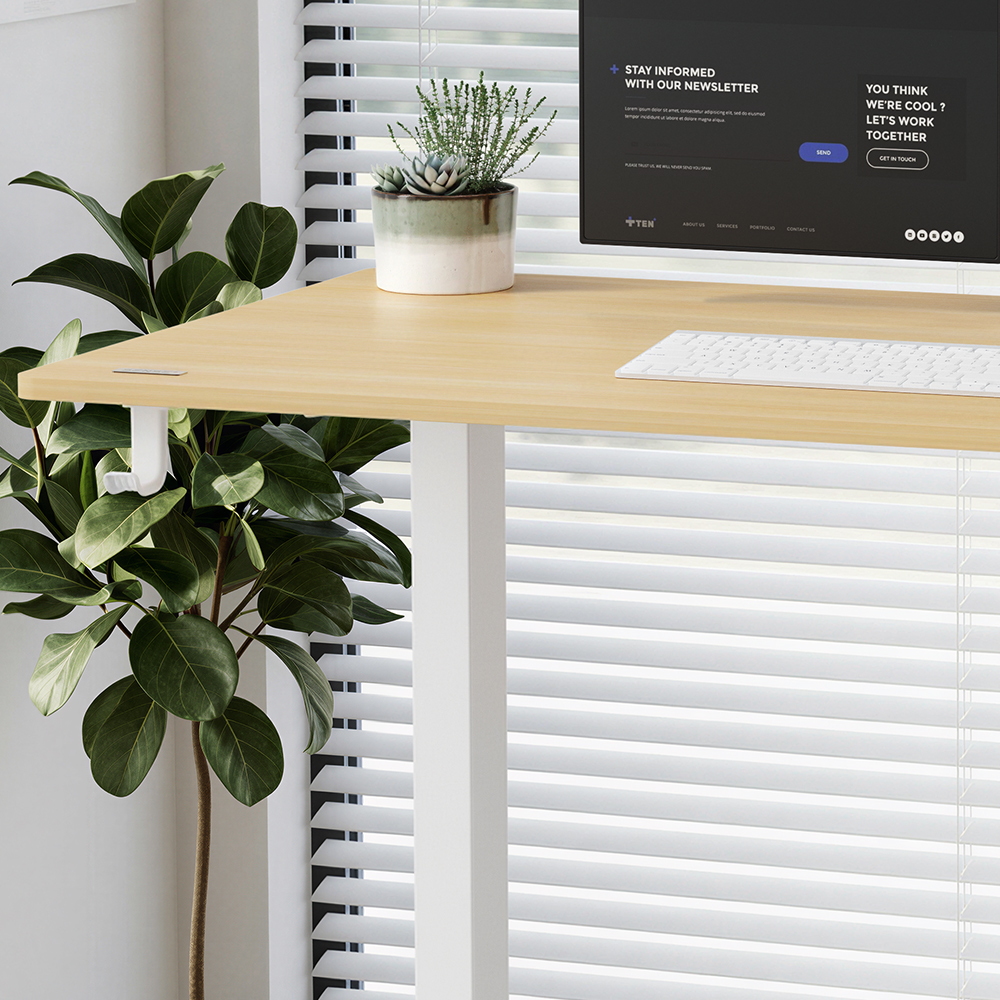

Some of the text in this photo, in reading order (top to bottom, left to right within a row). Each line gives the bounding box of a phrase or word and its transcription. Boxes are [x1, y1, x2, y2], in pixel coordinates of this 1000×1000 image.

[626, 65, 715, 77] STAY INFORMED
[625, 79, 758, 93] WITH OUR NEWSLETTER
[866, 84, 928, 96] YOU THINK
[905, 101, 937, 112] COOL
[940, 103, 946, 112] ?
[898, 116, 934, 127] WORK
[866, 131, 926, 142] TOGETHER
